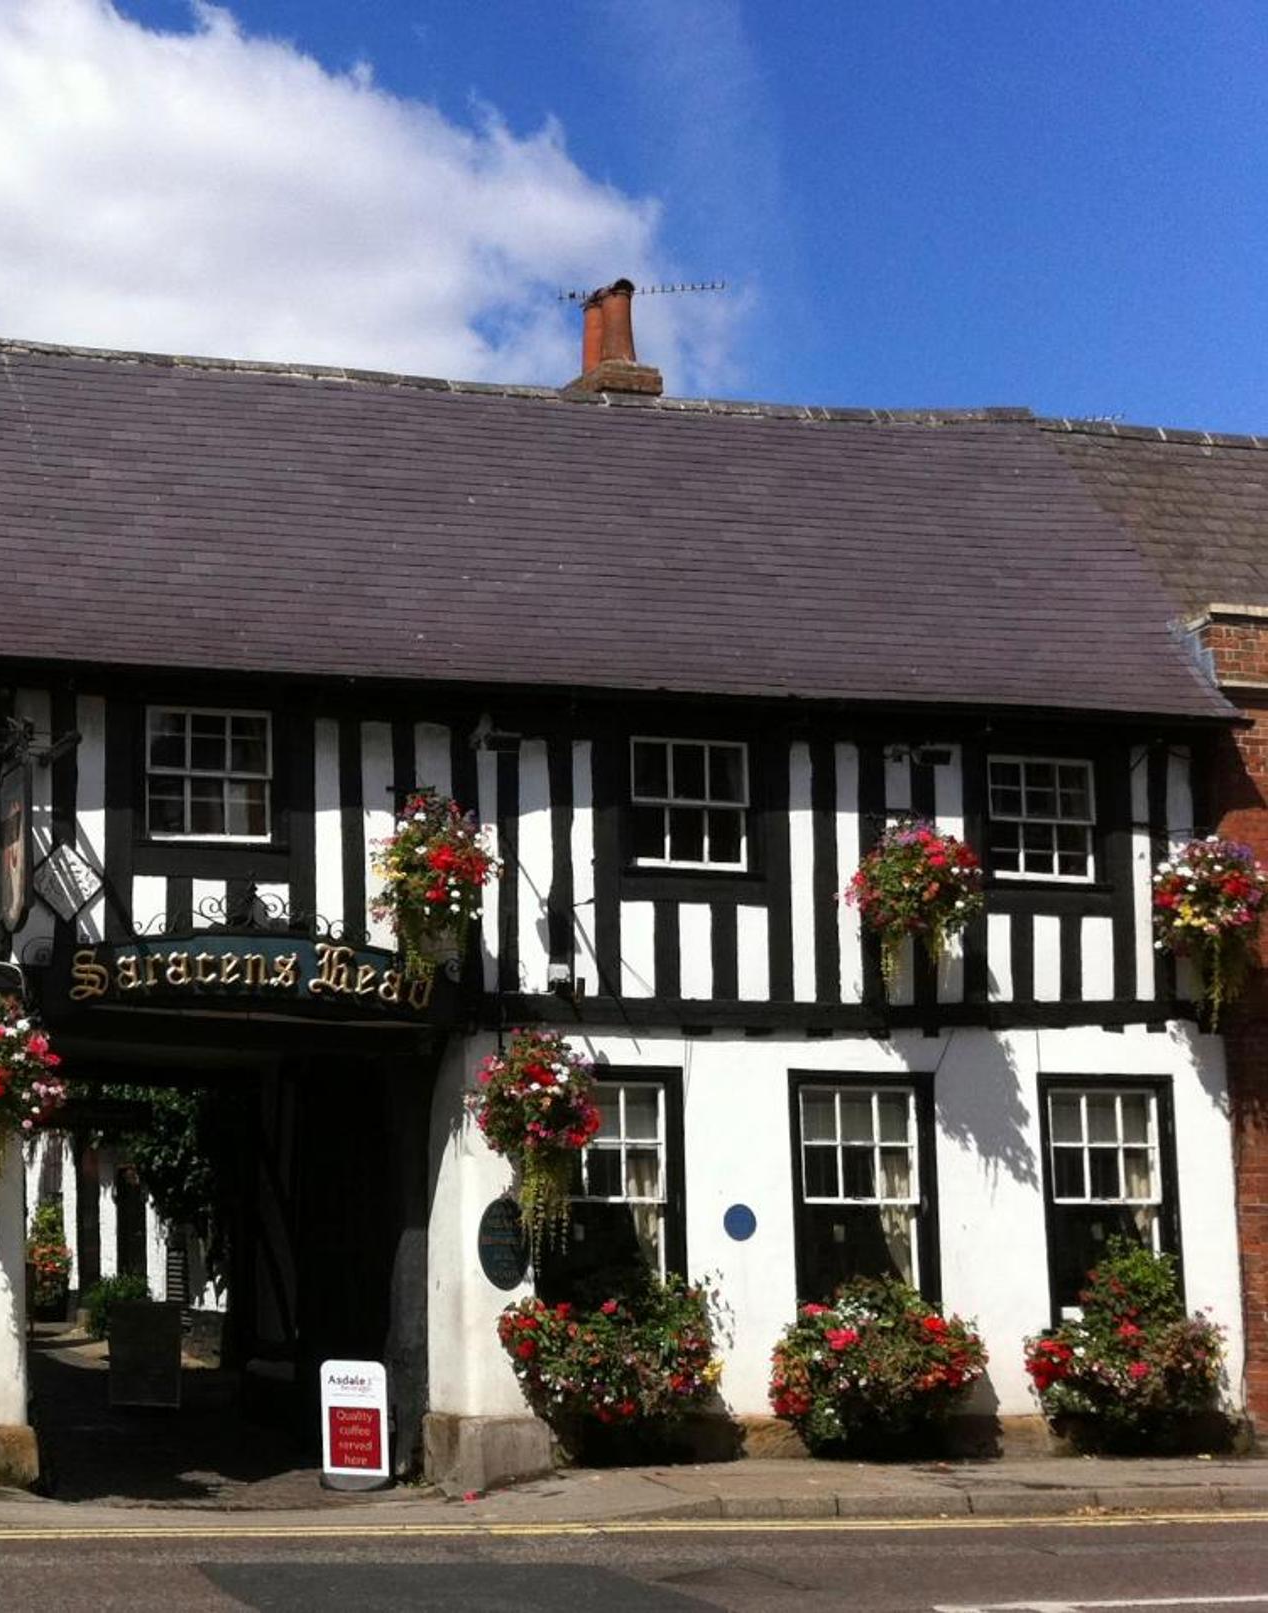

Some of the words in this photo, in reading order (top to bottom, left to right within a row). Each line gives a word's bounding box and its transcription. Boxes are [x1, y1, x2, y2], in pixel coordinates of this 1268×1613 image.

[68, 946, 298, 1001] Saracens
[308, 942, 433, 1010] Head
[327, 1375, 366, 1386] Asdale
[336, 1409, 373, 1423] Quality
[339, 1425, 371, 1436] coffee
[338, 1441, 373, 1451] served
[344, 1454, 368, 1466] here
